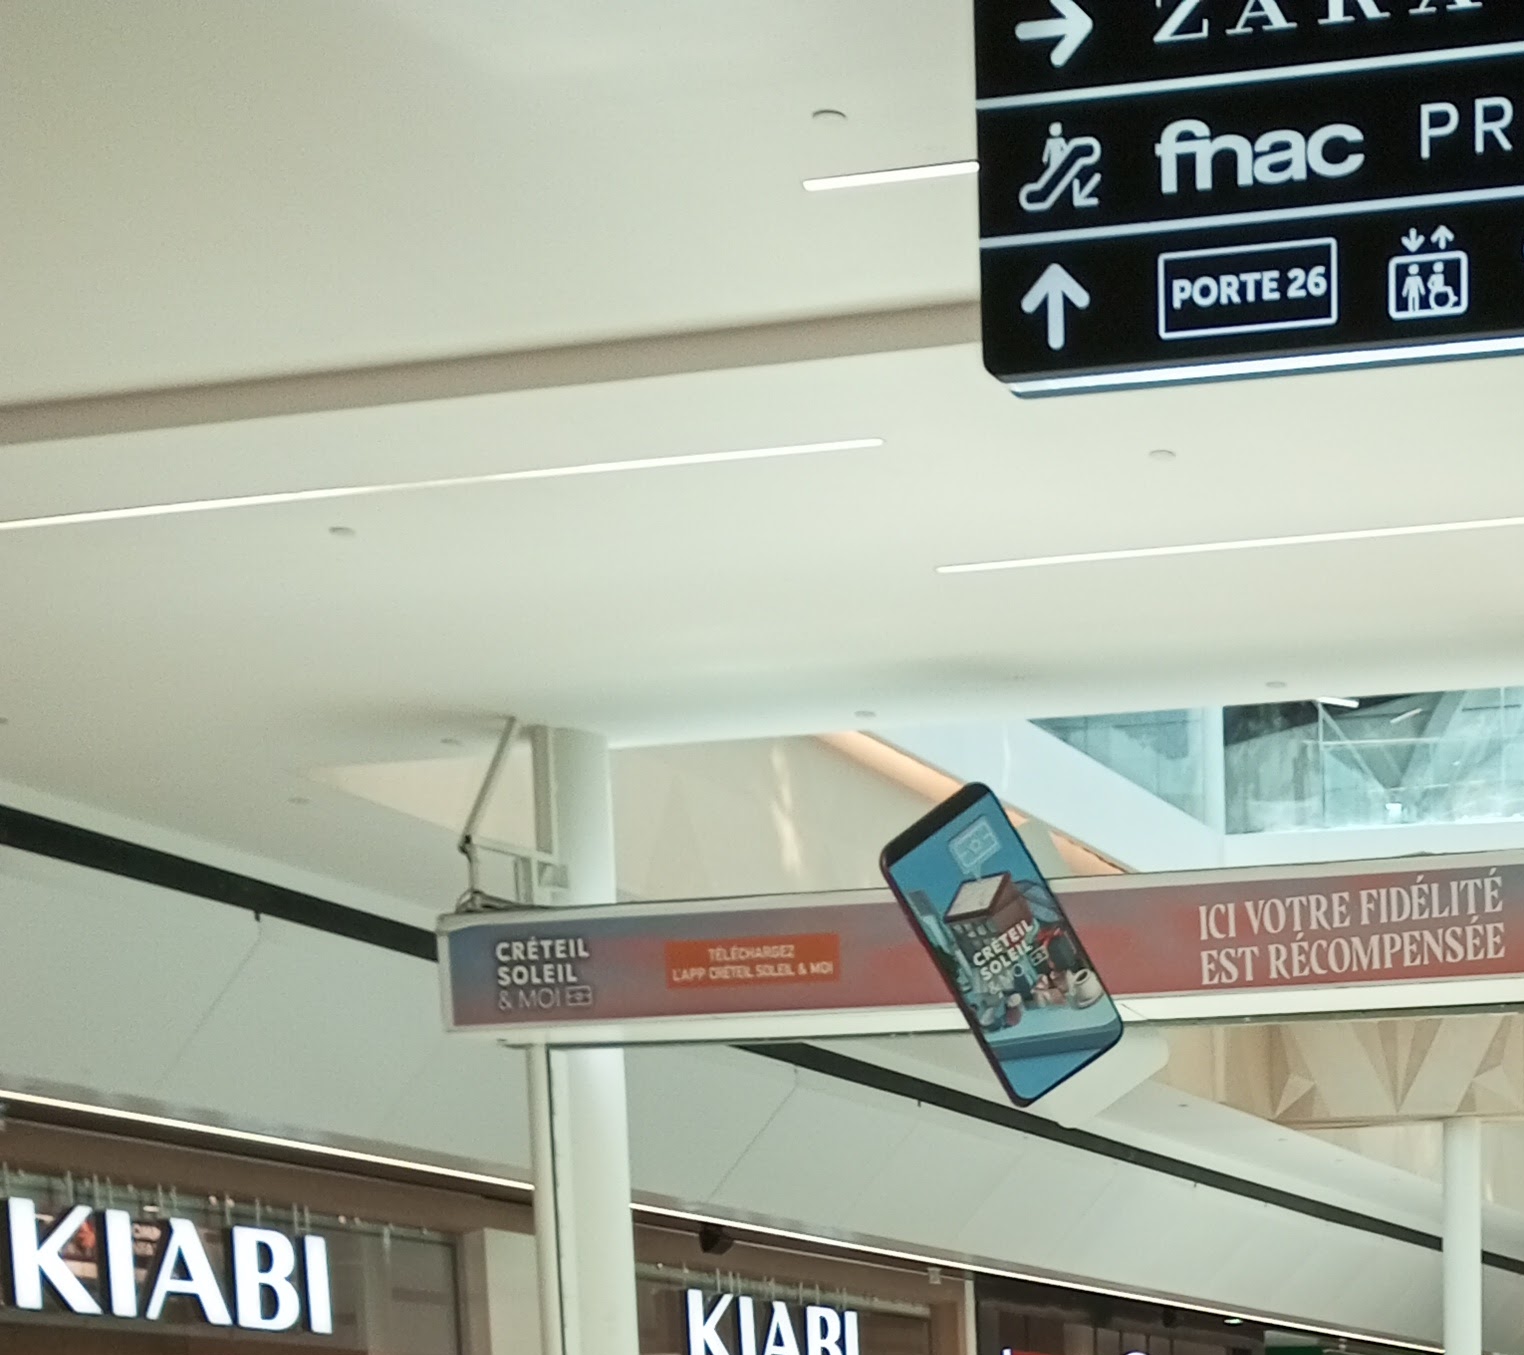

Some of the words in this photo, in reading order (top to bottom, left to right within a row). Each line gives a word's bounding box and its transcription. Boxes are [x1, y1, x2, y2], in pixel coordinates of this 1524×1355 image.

[1154, 119, 1365, 194] fnac
[1172, 270, 1281, 310] PORTE
[1287, 265, 1328, 300] 26
[1199, 902, 1237, 941] ICI
[1246, 891, 1351, 936] VOTRE
[1360, 867, 1503, 926] FIDÉLITÉ
[496, 935, 589, 962] CRÉTEIL
[708, 944, 795, 962] TÉLÉCHARGEZ
[980, 940, 1034, 981] SOLEIL
[1201, 945, 1259, 985] EST
[1268, 914, 1506, 980] RÉCOMPENSÉE
[497, 963, 578, 986] SOLEIL
[755, 962, 795, 978] SOLEIL
[519, 987, 560, 1009] MOI
[8, 1197, 333, 1334] KIABI
